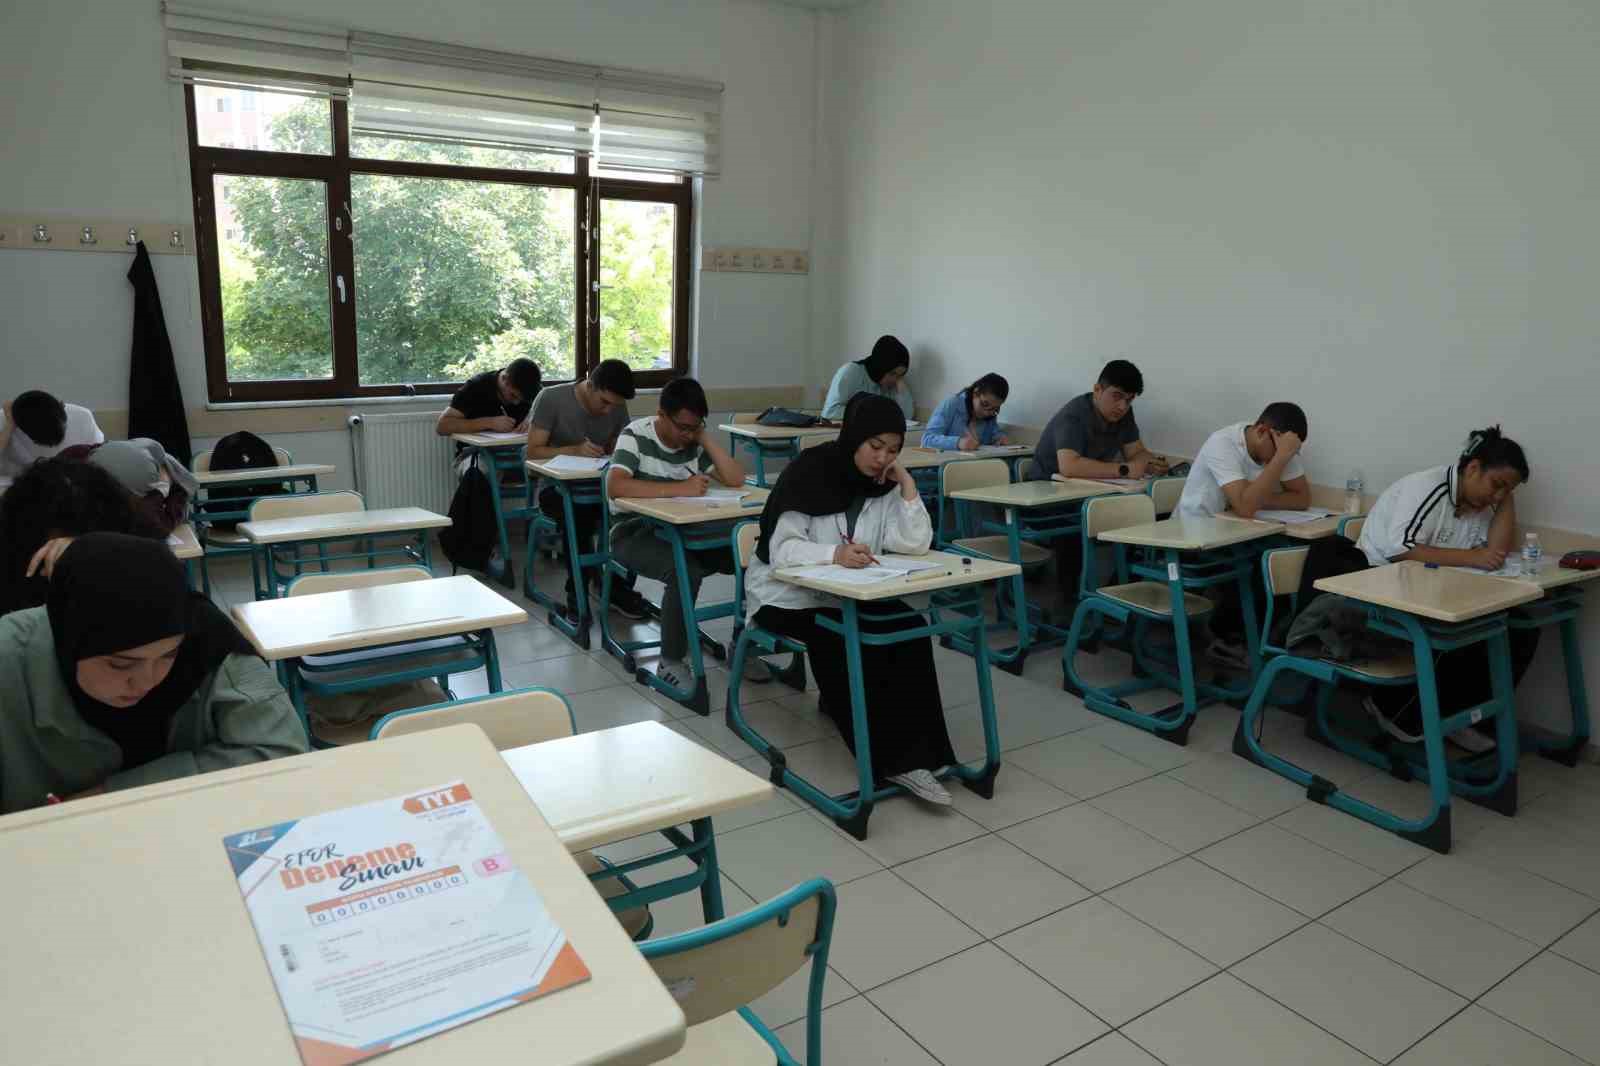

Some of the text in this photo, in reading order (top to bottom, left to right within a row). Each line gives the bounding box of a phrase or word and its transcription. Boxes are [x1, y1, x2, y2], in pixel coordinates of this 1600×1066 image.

[418, 789, 456, 811] TYT
[280, 842, 416, 889] Deneme
[284, 843, 343, 868] EFOR
[482, 859, 499, 873] B
